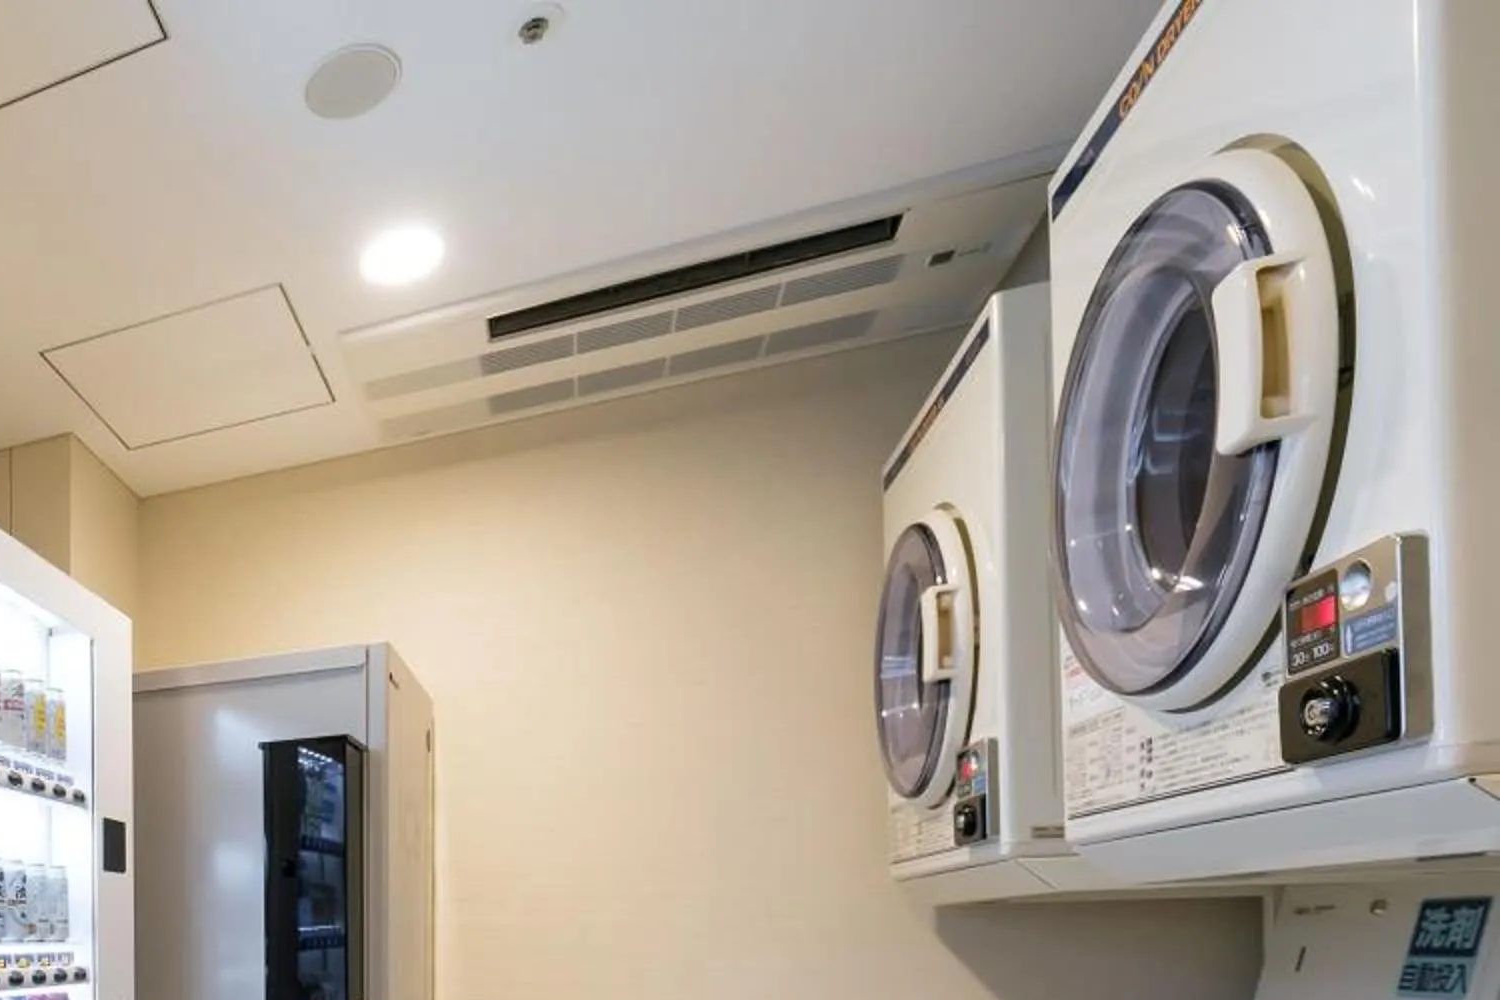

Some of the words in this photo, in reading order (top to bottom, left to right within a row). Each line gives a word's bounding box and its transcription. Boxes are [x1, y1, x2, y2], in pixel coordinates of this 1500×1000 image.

[1414, 904, 1483, 948] 洗剤
[1397, 963, 1467, 993] 自動投入
